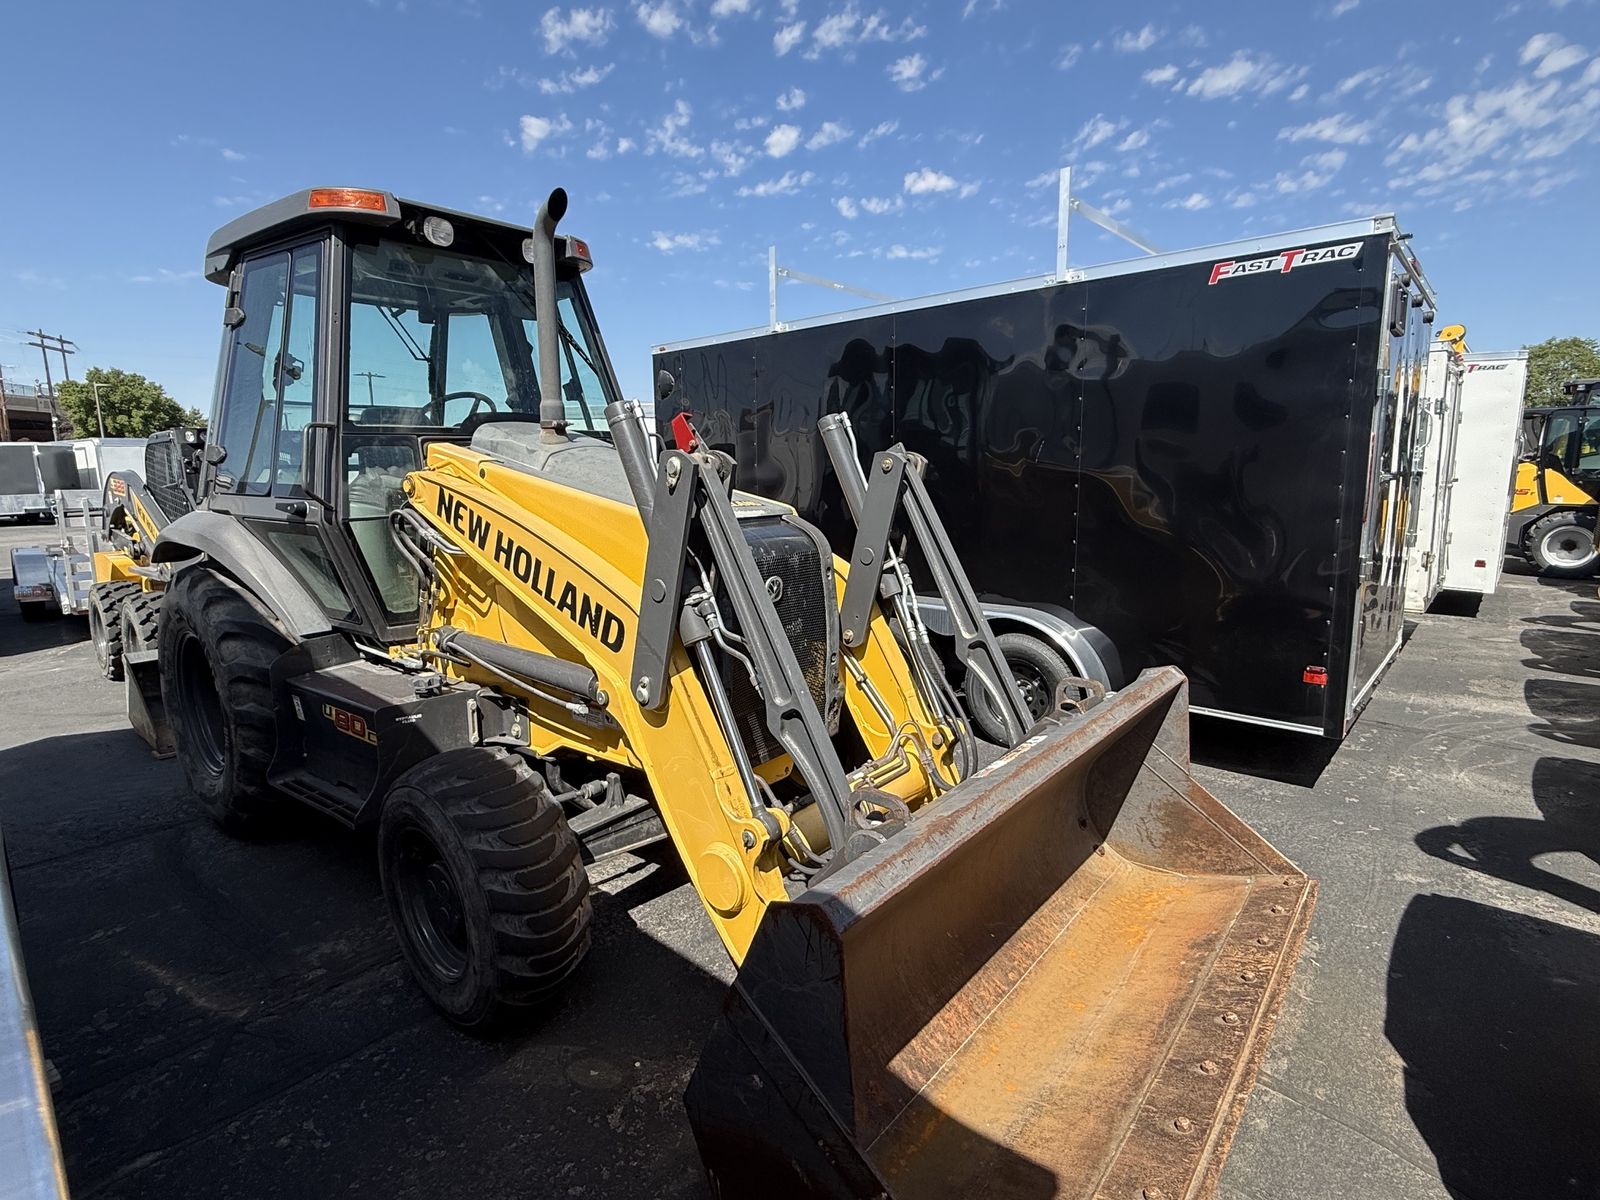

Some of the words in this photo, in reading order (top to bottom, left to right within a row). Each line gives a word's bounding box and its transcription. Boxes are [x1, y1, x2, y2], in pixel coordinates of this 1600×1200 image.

[1209, 258, 1278, 284] FAST
[1281, 246, 1356, 273] TRAC
[1467, 364, 1506, 373] TRAC
[437, 486, 491, 551] NEW
[494, 529, 625, 653] HOLLAND
